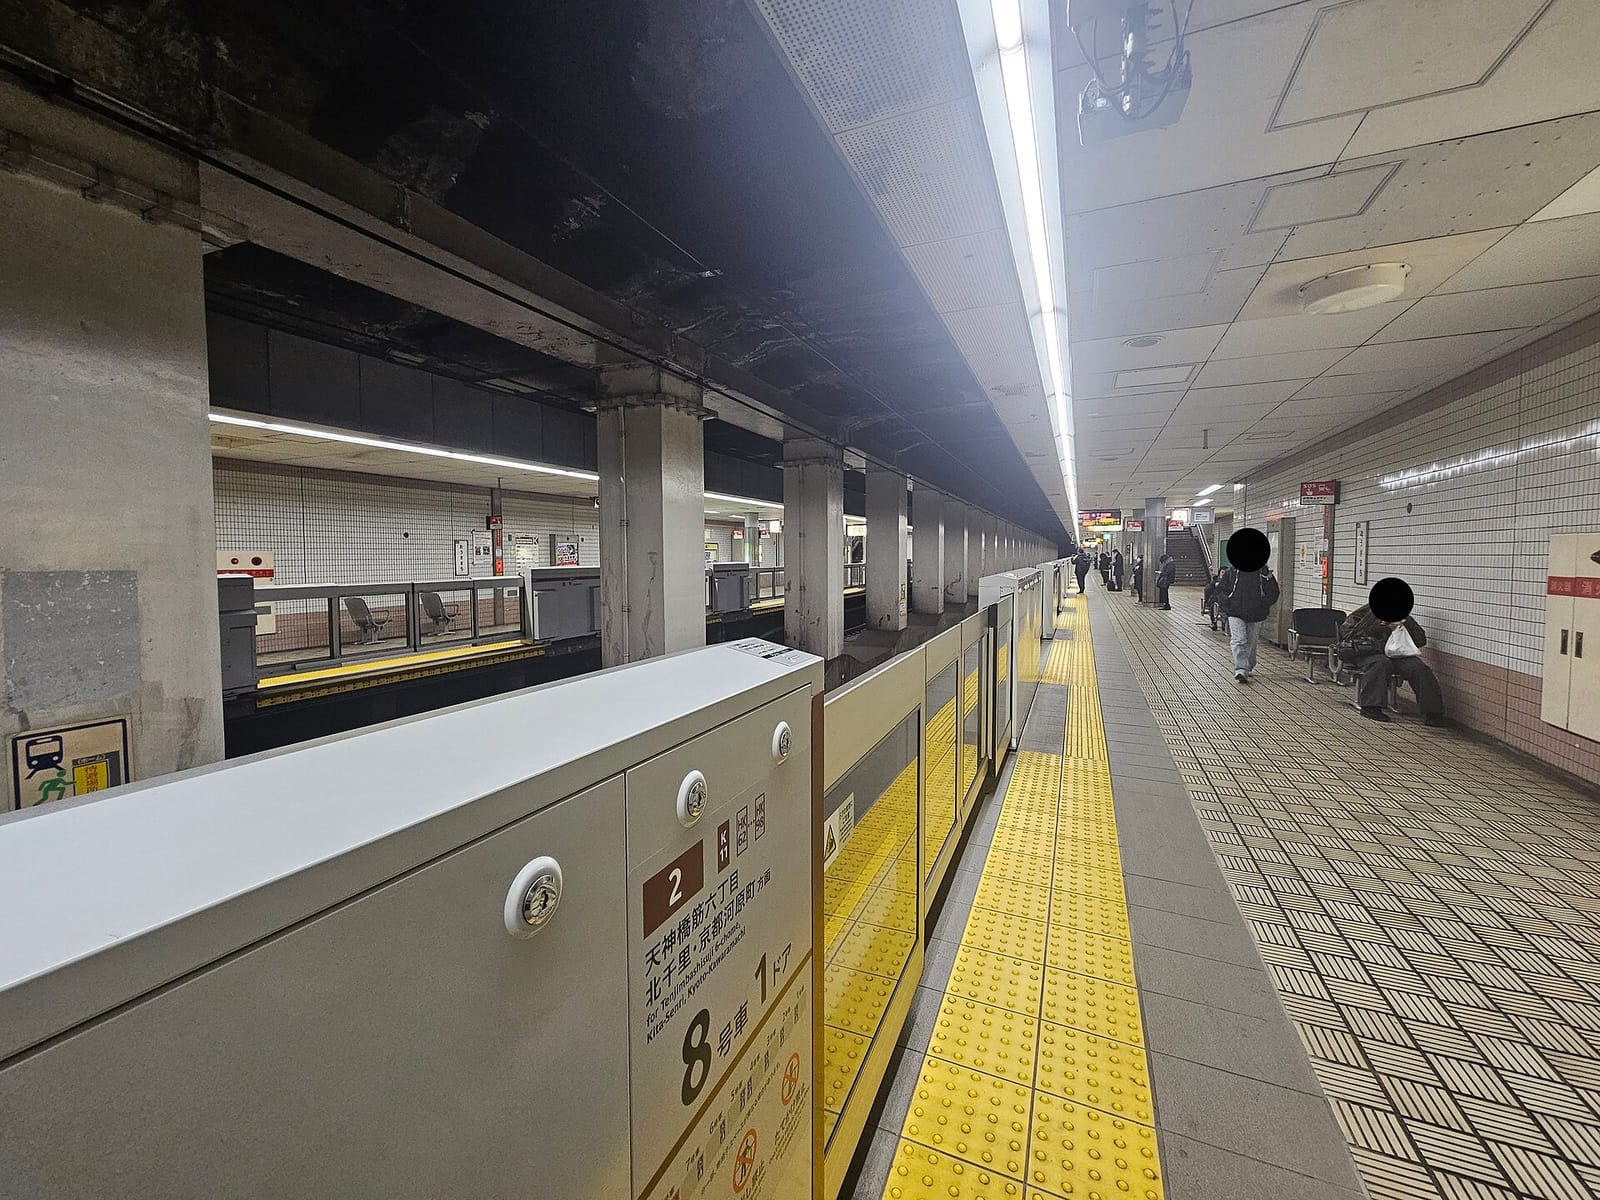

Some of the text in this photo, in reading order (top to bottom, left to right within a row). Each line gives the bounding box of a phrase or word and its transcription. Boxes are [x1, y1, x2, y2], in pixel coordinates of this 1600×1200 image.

[719, 847, 729, 862] 11
[720, 830, 727, 845] K
[668, 867, 683, 907] 2
[645, 869, 739, 977] 天神橋筋六丁目
[647, 926, 746, 1045] Kita-Senri, Kyoto-Kawaramachi
[647, 1008, 659, 1027] for
[661, 947, 714, 1010] Tenjimbashisuji
